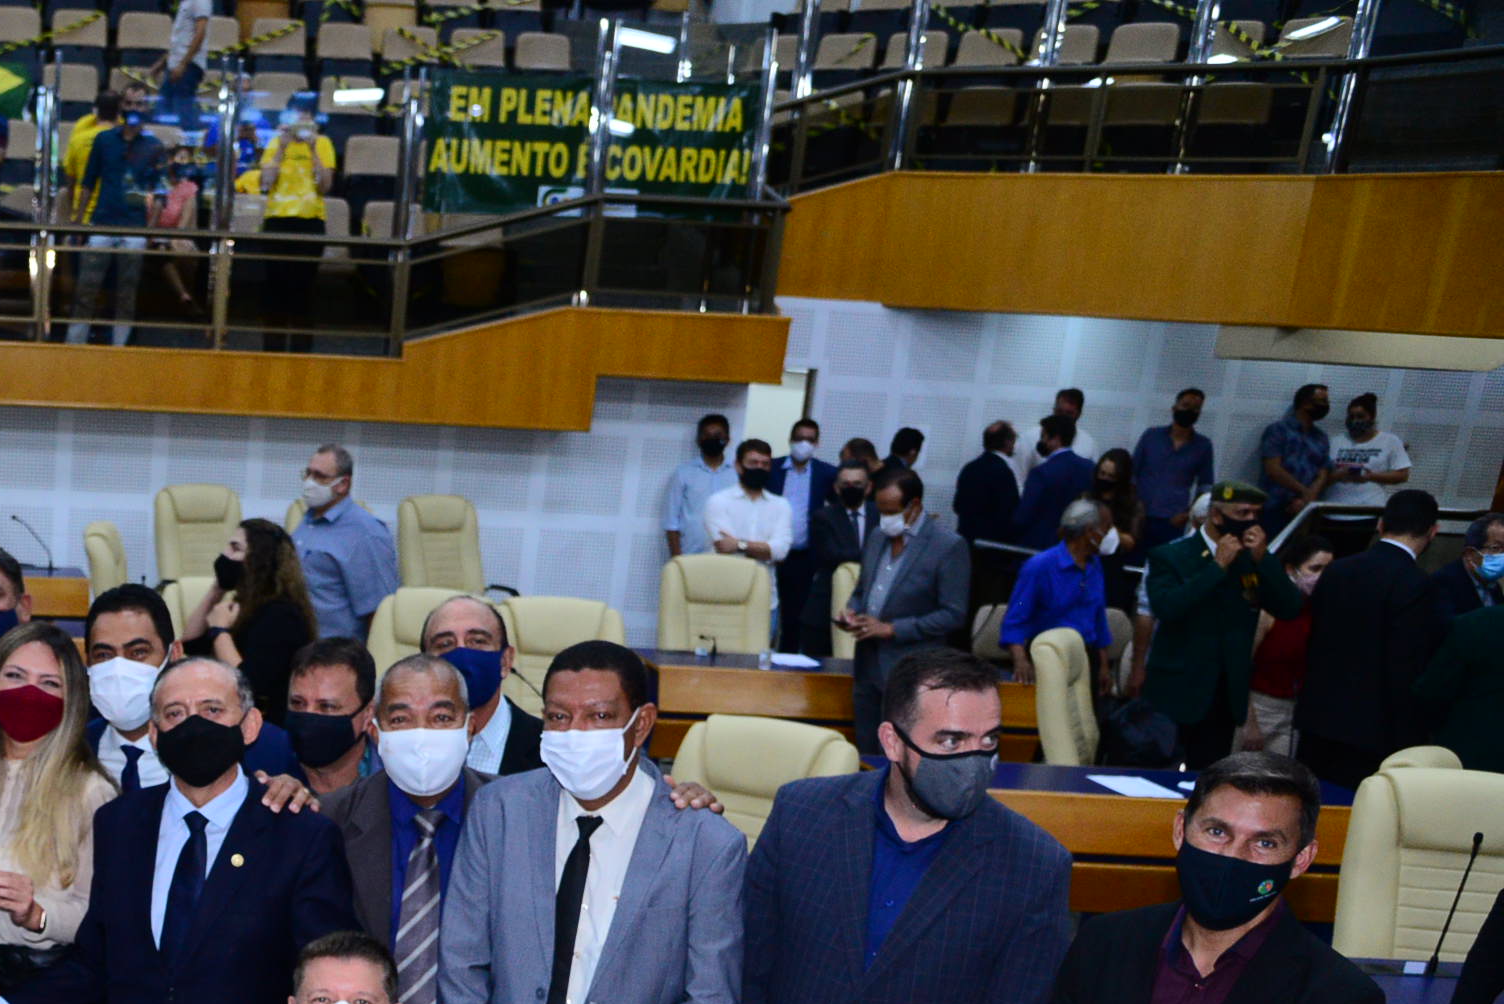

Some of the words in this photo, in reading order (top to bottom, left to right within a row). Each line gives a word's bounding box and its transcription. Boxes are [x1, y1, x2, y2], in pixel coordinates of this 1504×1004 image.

[449, 86, 493, 124] EM
[499, 88, 590, 128] PLENA
[612, 93, 744, 132] ANDEMIA
[429, 137, 570, 178] AUMENTO
[604, 145, 751, 185] COVARDIA!
